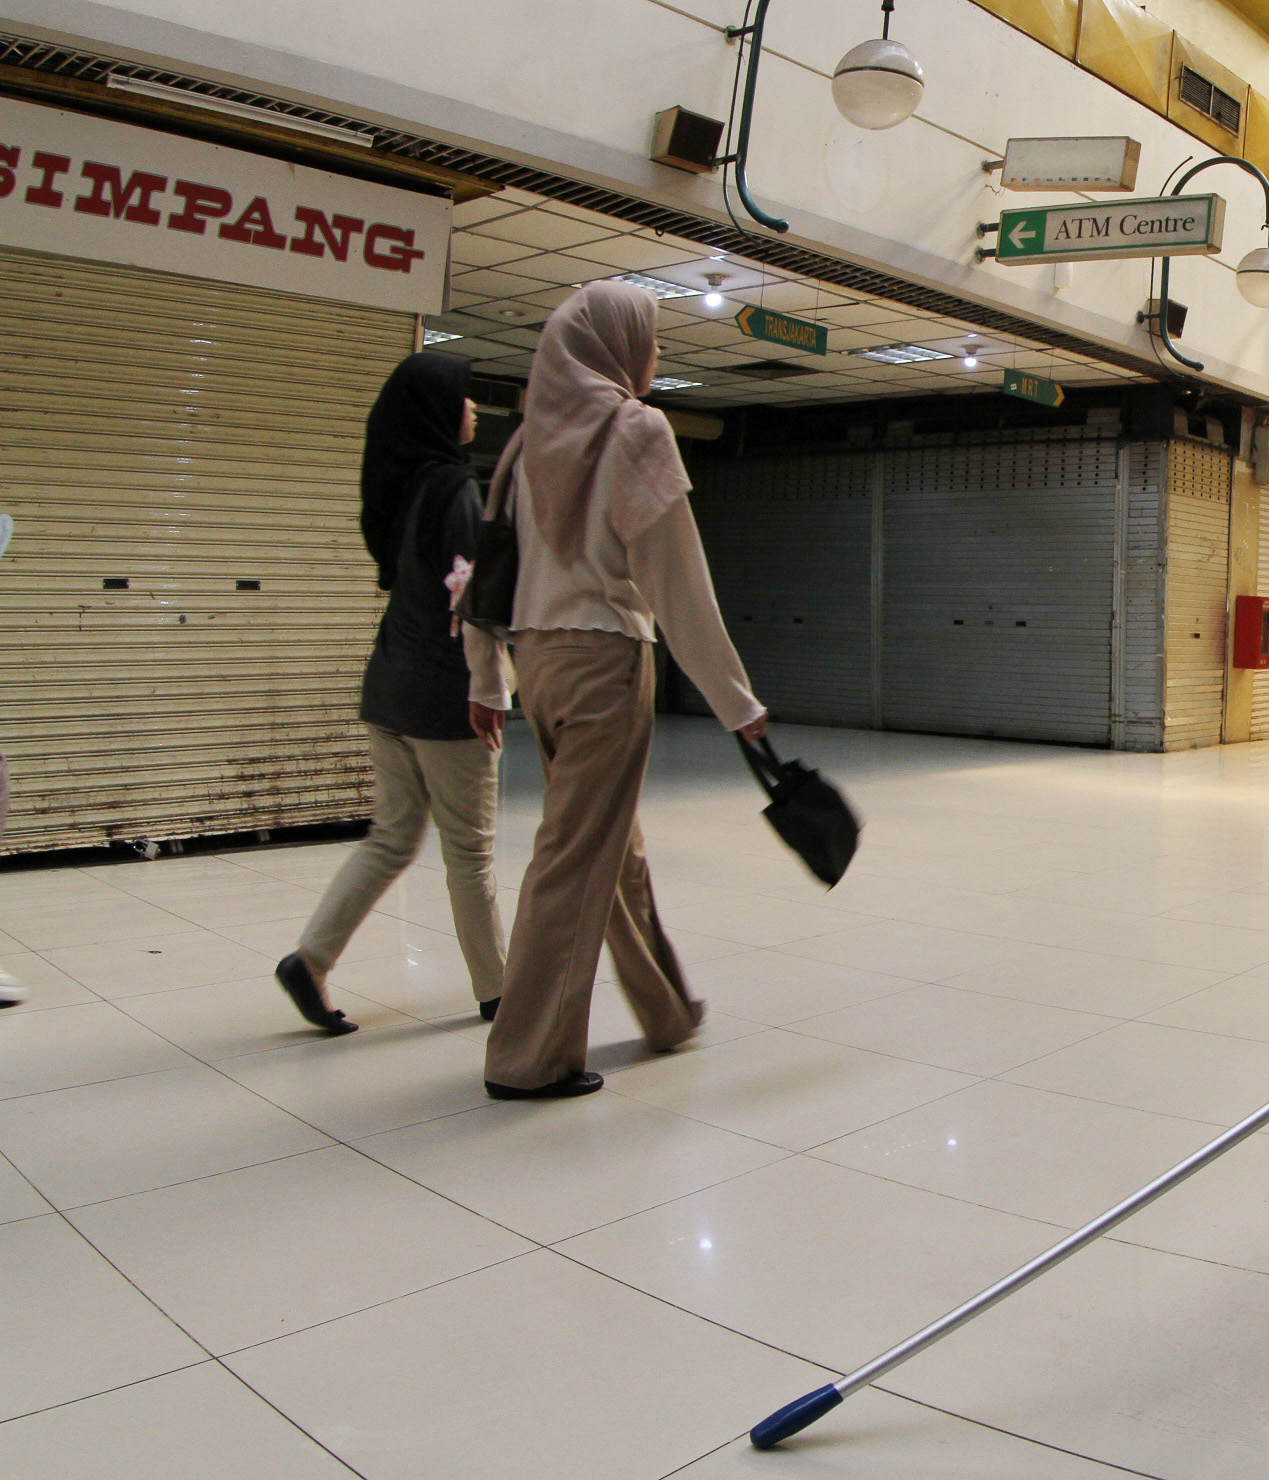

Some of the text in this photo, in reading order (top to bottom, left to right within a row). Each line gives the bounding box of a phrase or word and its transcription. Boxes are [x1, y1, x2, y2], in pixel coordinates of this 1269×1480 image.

[1053, 213, 1195, 241] ATM Centre
[764, 315, 817, 349] TRANSJAKARTA
[1021, 376, 1039, 398] MRT
